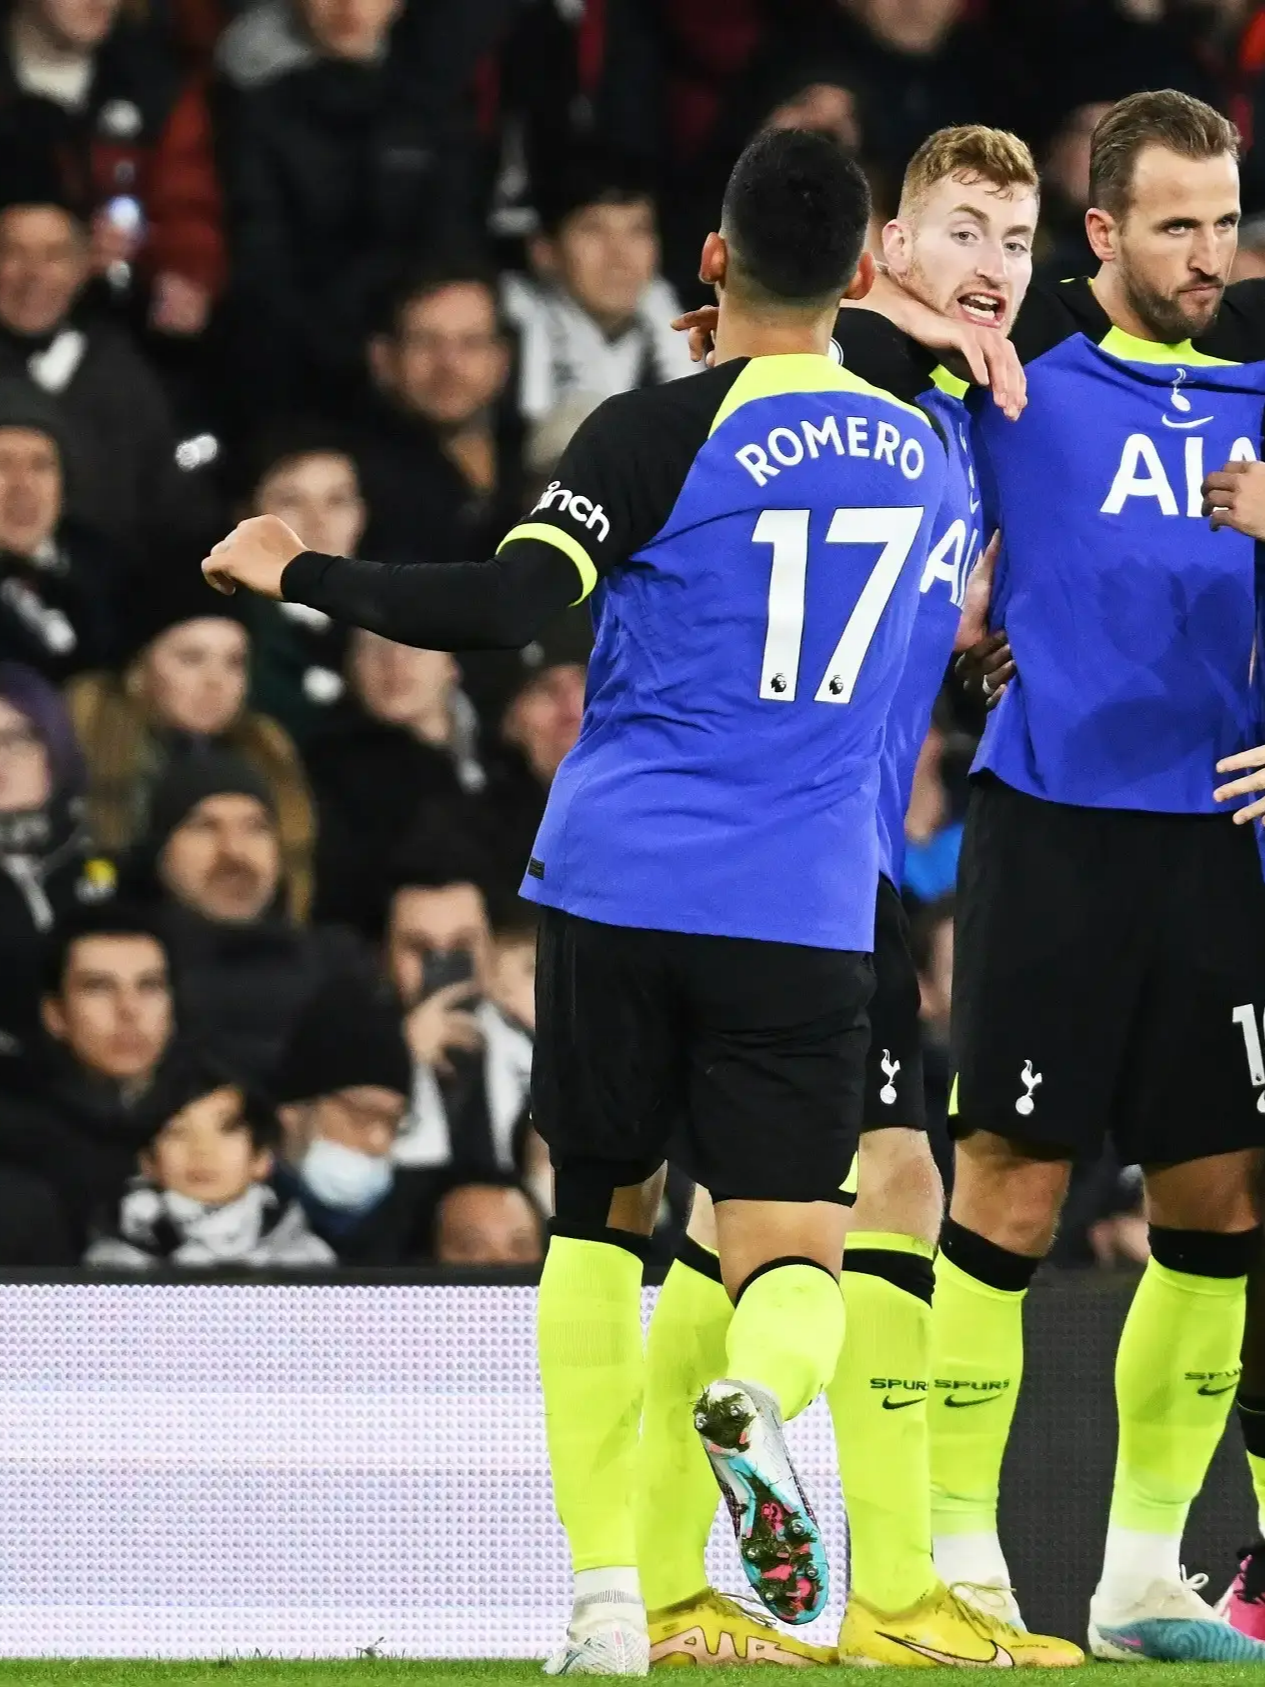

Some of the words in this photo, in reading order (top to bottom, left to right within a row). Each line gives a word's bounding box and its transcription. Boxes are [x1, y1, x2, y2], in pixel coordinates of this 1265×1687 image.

[735, 415, 926, 488] ROMERO
[530, 480, 610, 543] inch
[751, 505, 926, 705] 17
[870, 1377, 930, 1392] SPUR
